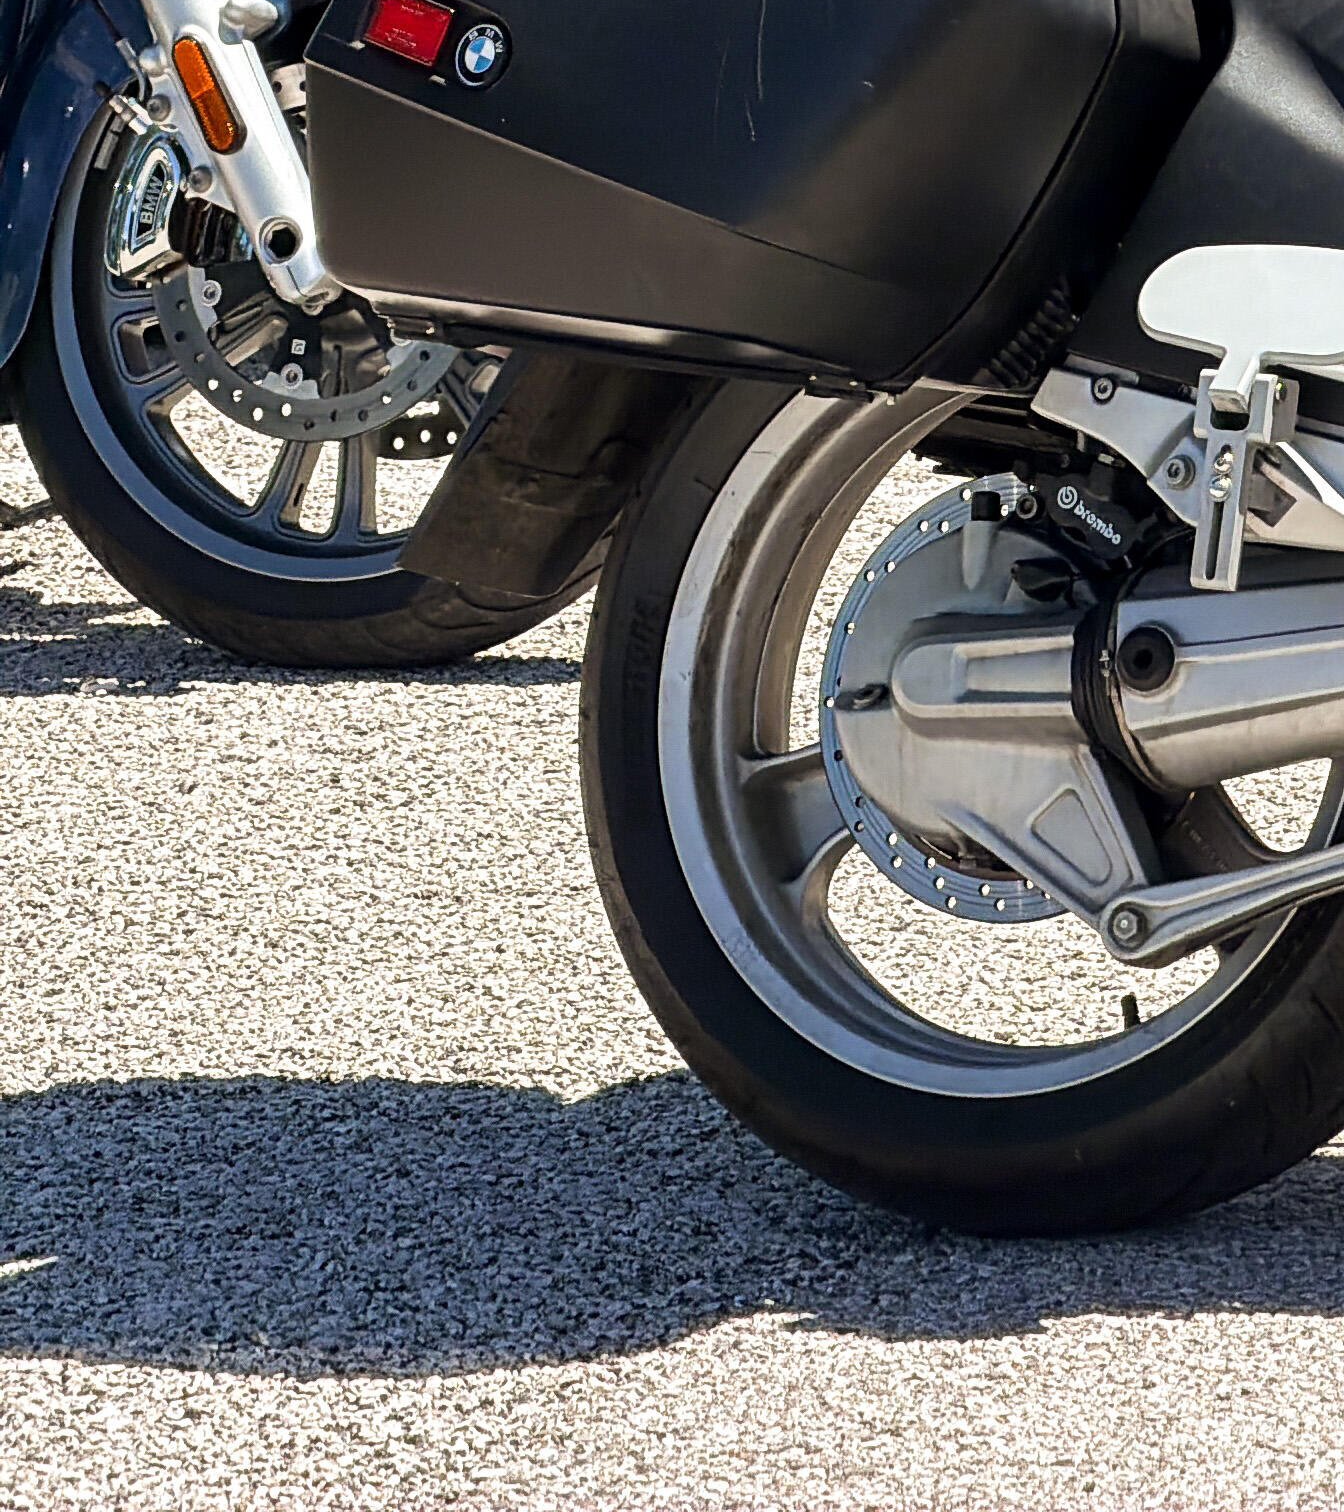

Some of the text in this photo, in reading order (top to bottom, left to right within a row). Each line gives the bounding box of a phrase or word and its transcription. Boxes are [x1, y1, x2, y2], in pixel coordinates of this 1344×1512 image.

[468, 28, 505, 54] BMW
[139, 175, 164, 225] BMW
[1073, 499, 1122, 546] brembo
